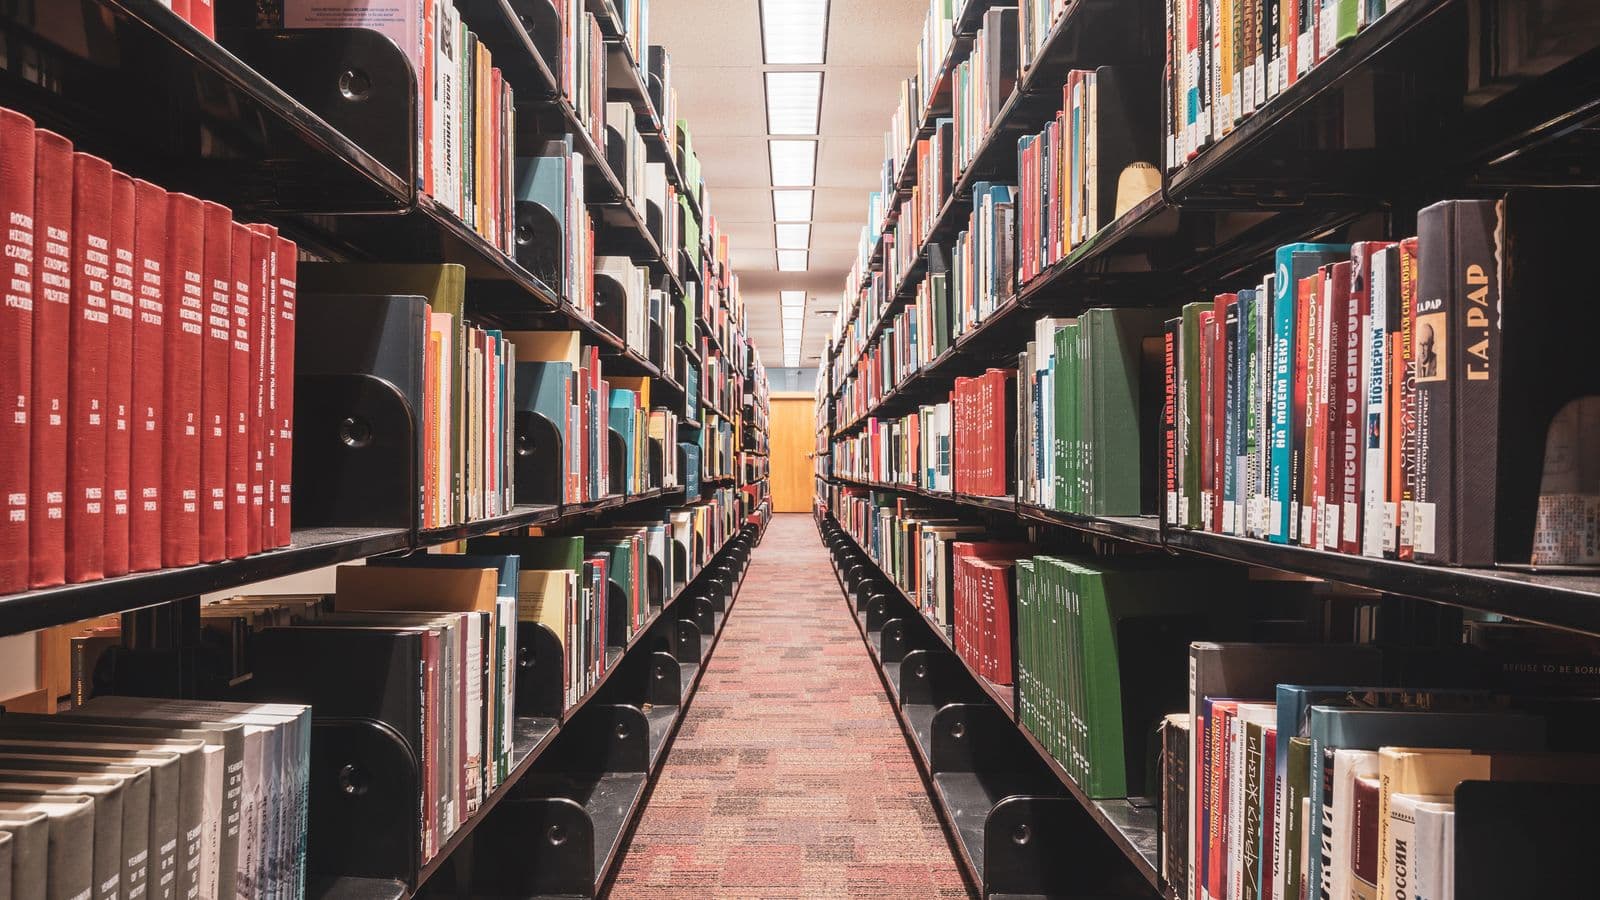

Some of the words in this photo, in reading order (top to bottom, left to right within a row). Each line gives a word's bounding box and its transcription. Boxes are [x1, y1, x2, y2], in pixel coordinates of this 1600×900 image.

[1308, 293, 1316, 370] ПОЛЕВОЙ
[1347, 299, 1358, 393] ПОЗНЕР
[1373, 328, 1383, 404] ПОЗНЕРОМ
[1165, 332, 1174, 424] КОНДРАШОВ
[1278, 379, 1287, 425] МОЕМ
[1347, 399, 1357, 414] О
[1225, 411, 1233, 496] ПОДОБНЫЕ
[1277, 429, 1286, 448] НА
[1406, 361, 1416, 486] ПУШКИНОЙ
[1542, 664, 1556, 673] TO
[1559, 665, 1571, 674] BE
[1395, 839, 1407, 900] ОССИИ
